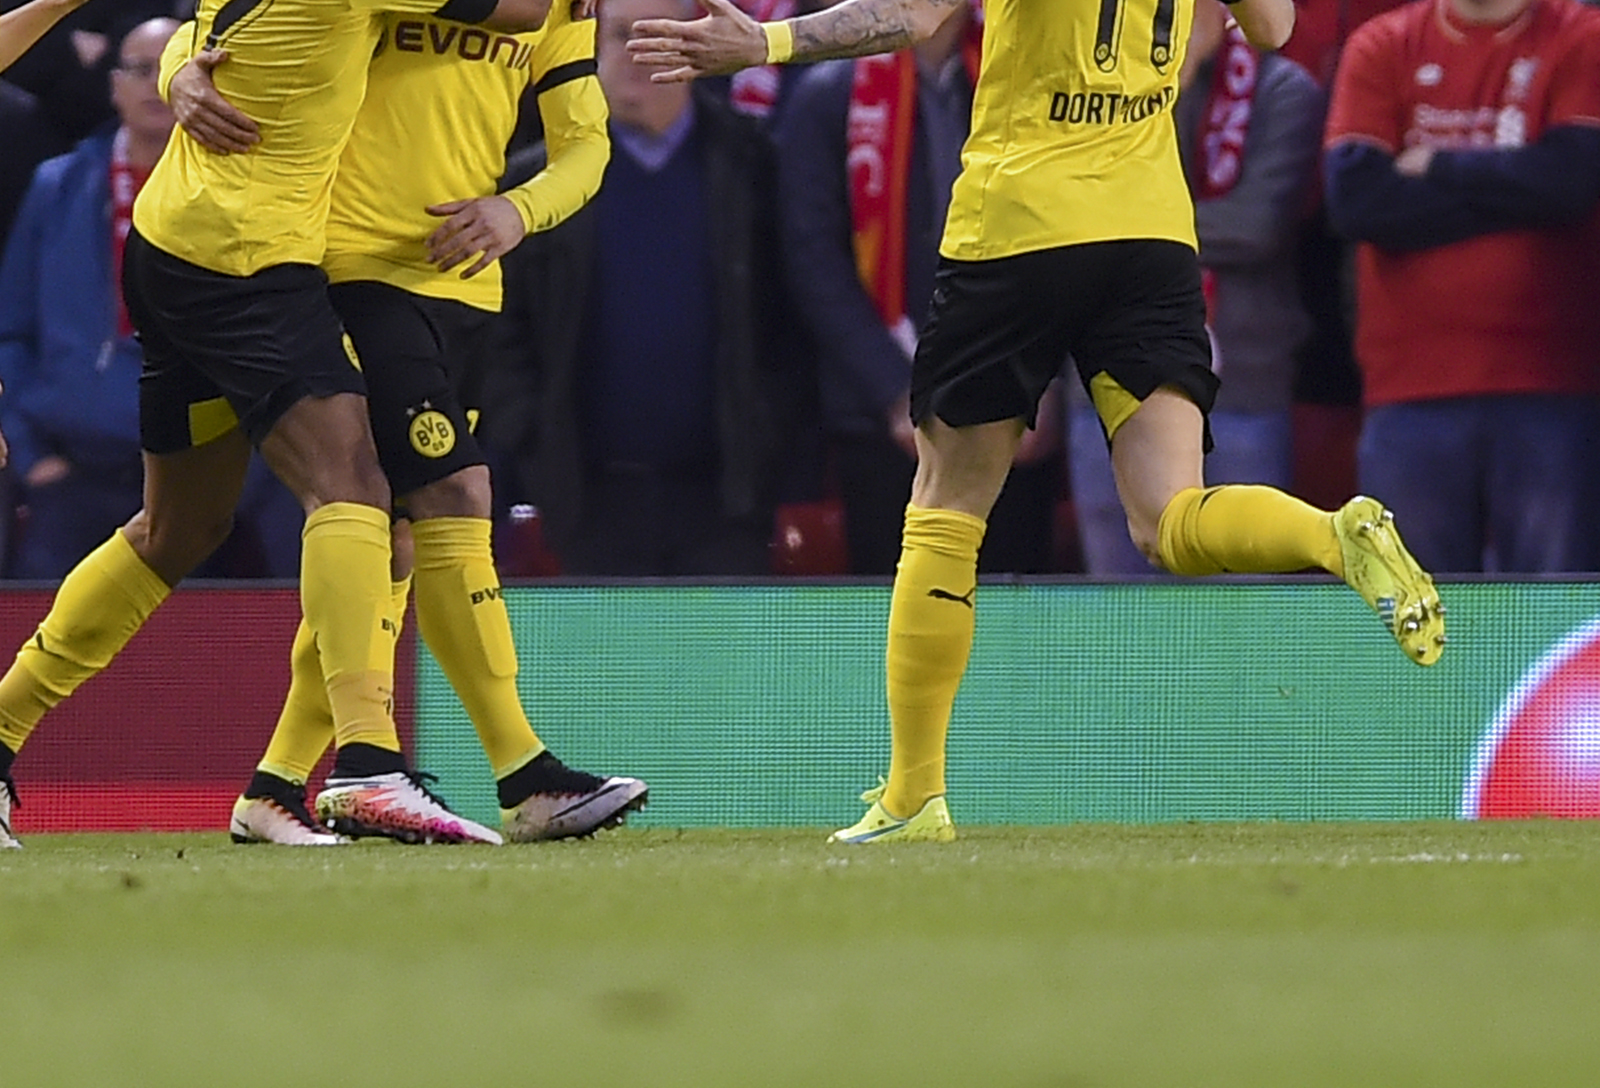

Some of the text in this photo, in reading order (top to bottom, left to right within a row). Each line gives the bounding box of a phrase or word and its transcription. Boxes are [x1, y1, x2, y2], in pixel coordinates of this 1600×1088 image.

[394, 20, 536, 71] EVONI
[1048, 85, 1175, 125] DORTMUND
[416, 416, 450, 448] BVB
